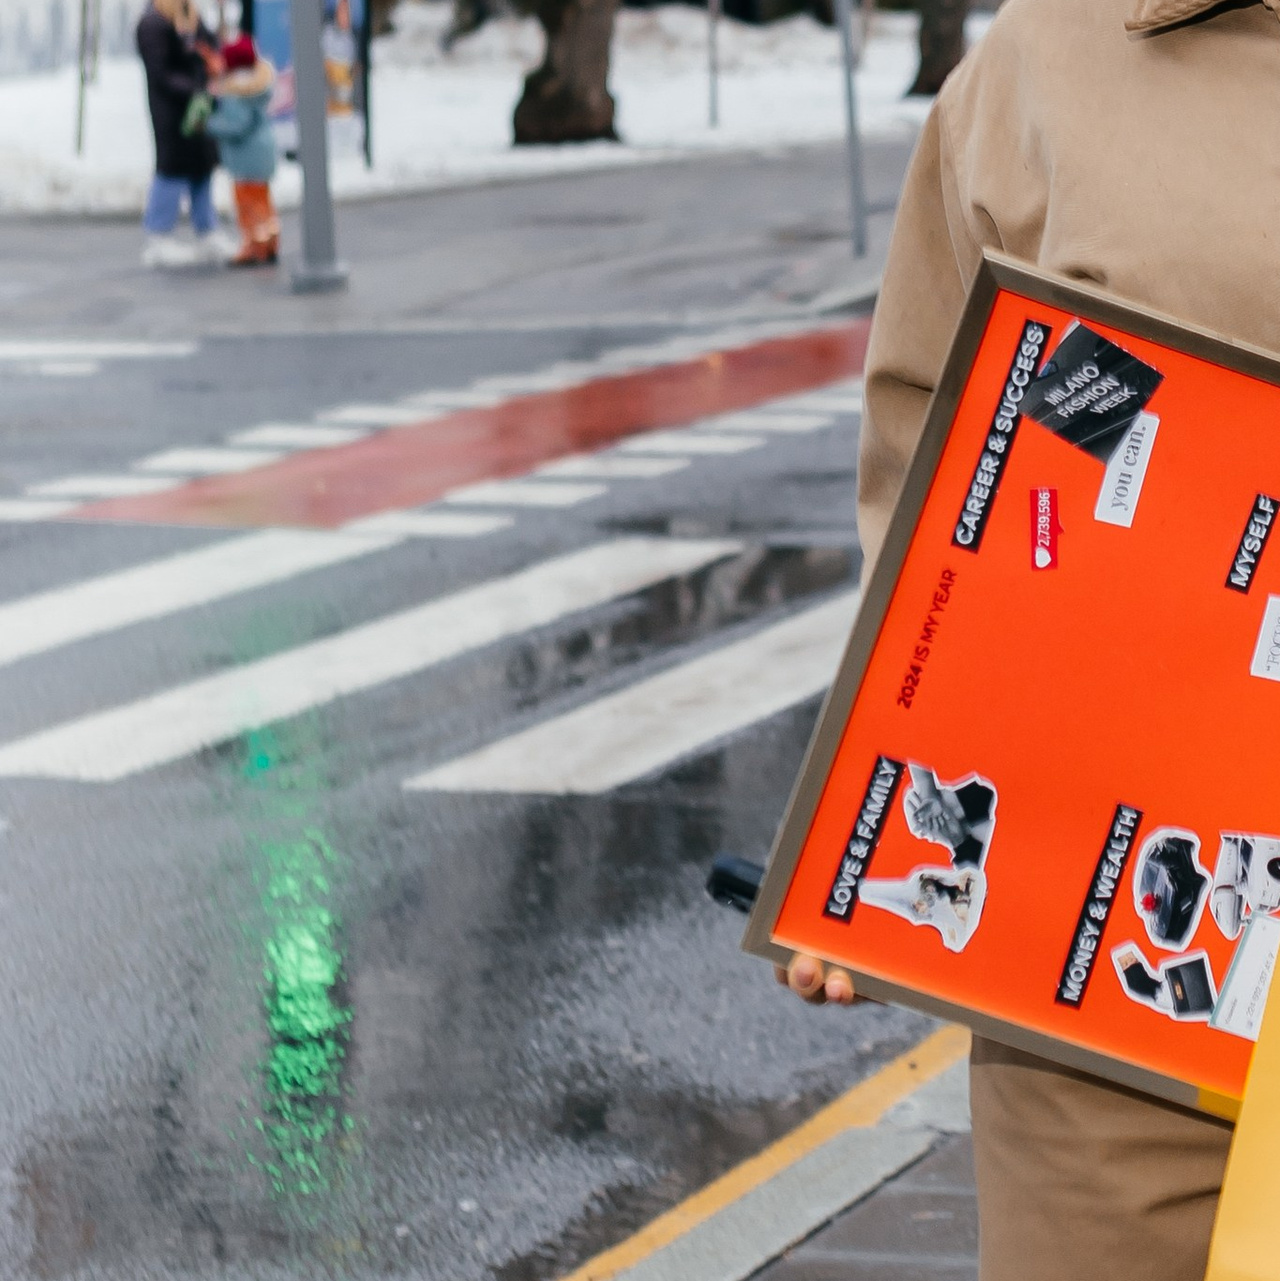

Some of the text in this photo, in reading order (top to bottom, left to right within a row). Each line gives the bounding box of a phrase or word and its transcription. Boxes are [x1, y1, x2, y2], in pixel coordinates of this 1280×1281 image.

[1044, 361, 1101, 406] MILANO
[1057, 375, 1121, 418] FASHION
[1090, 385, 1138, 415] WEEK
[955, 323, 1045, 545] CAREER & SUCCESS
[1110, 423, 1148, 511] you can.
[1037, 490, 1051, 547] 2,739,596
[1231, 494, 1276, 588] MYSELF
[897, 569, 957, 710] 2024 IS MY YEAR
[829, 756, 898, 917] LOVE & FAMILY
[1063, 806, 1138, 1002] MONEY & WEALTH
